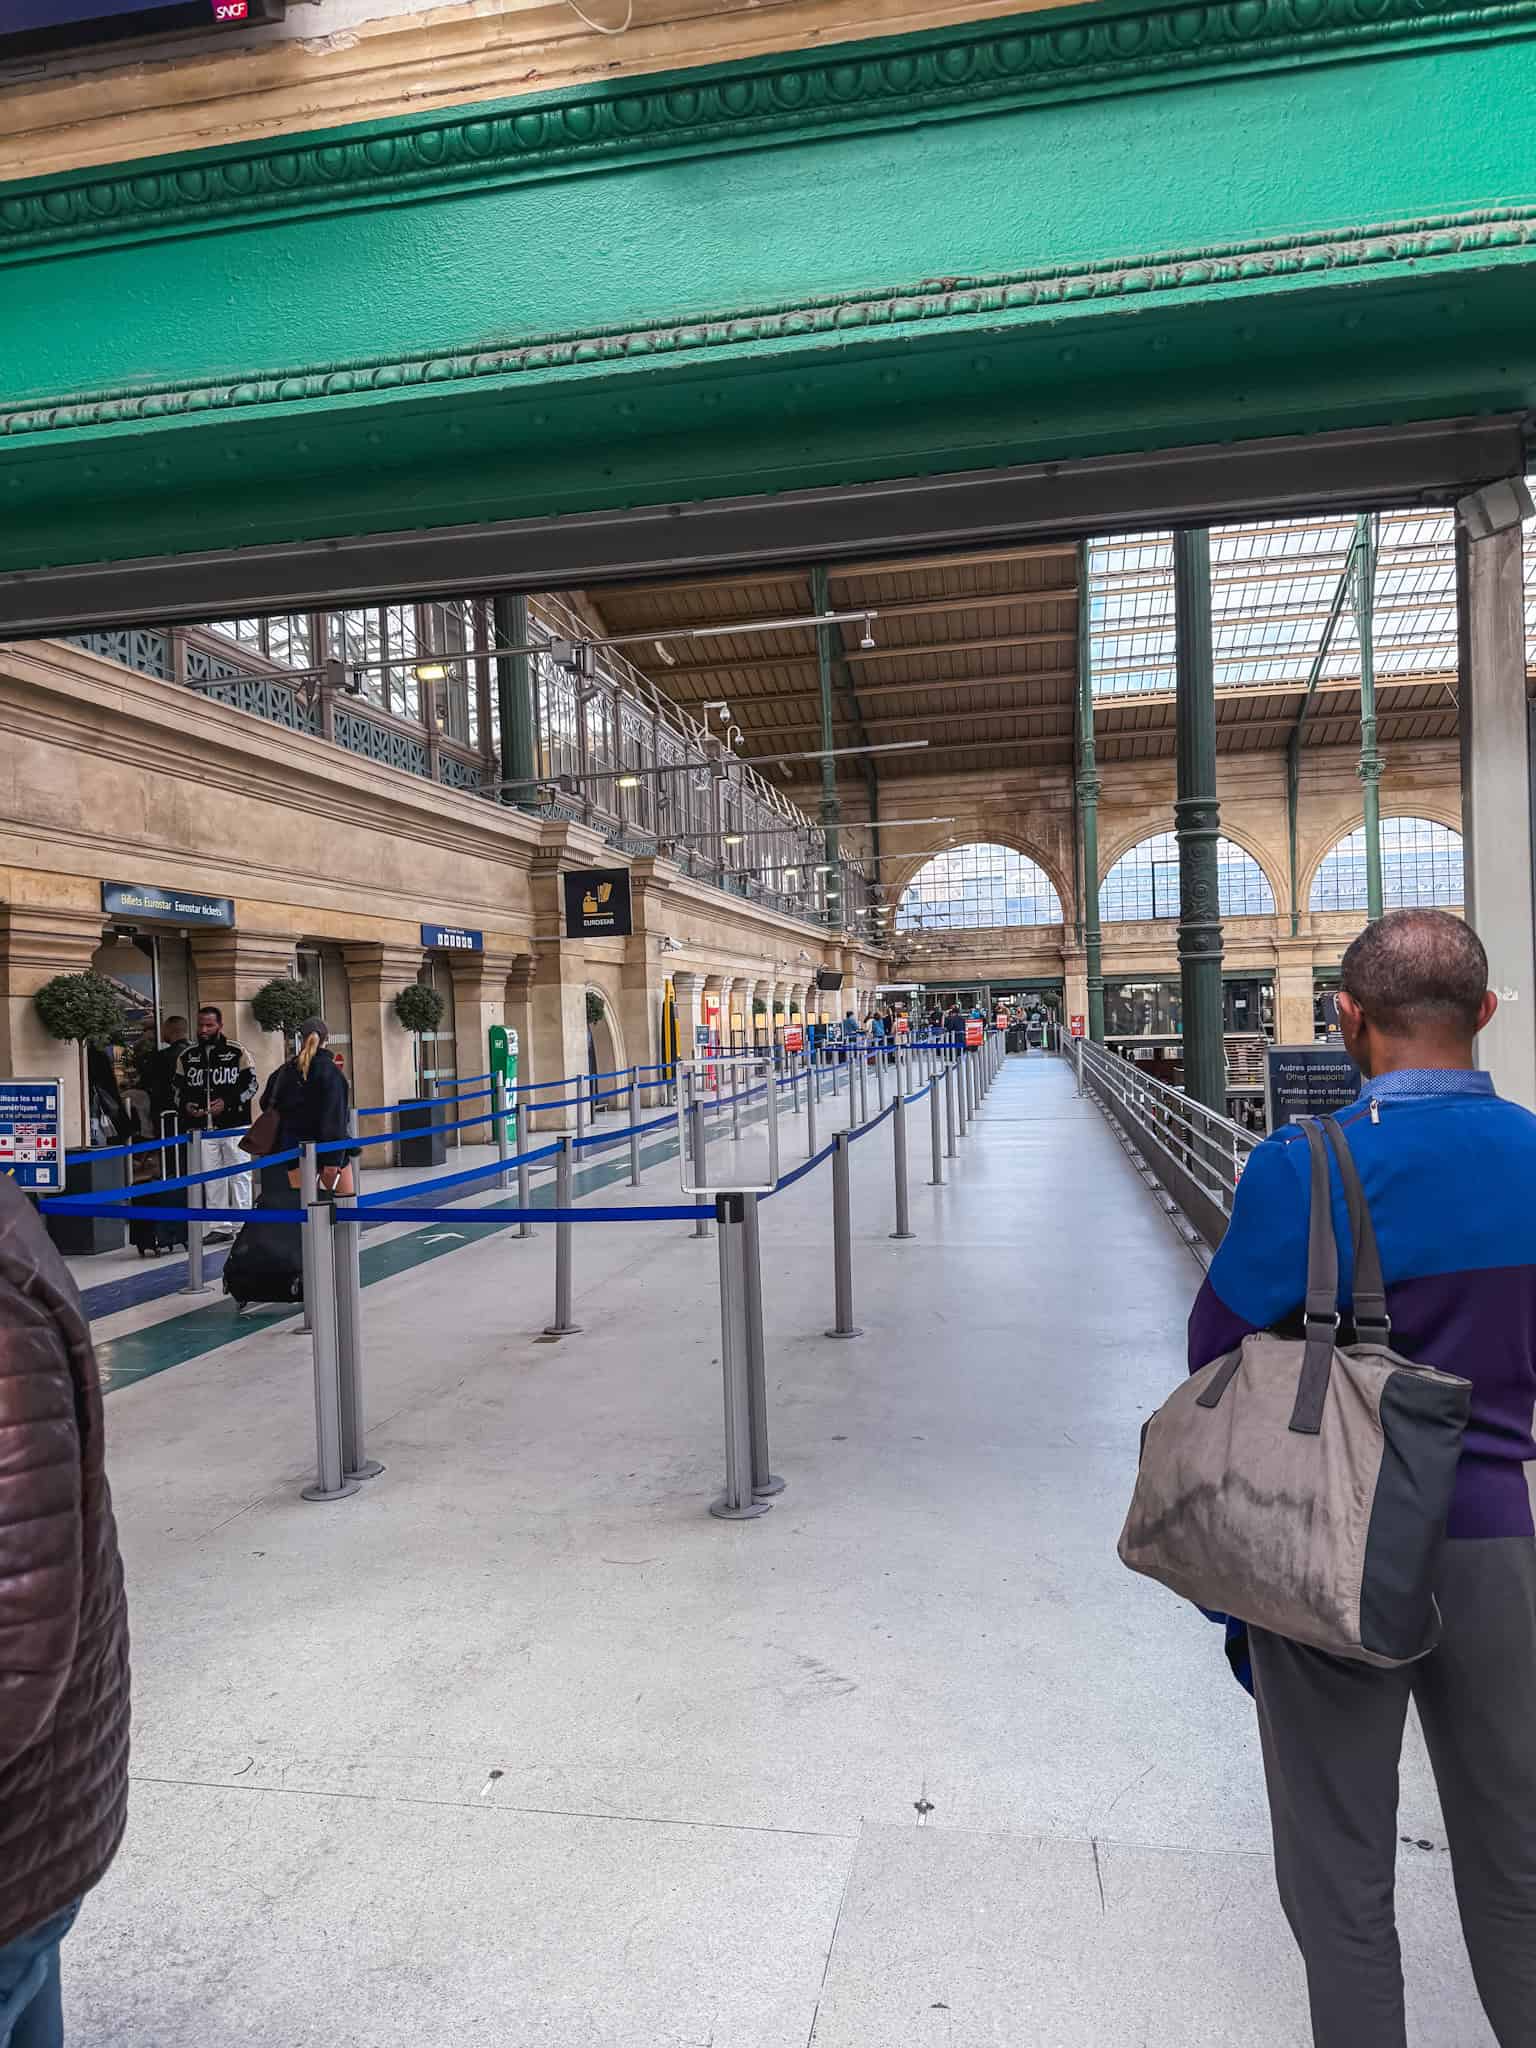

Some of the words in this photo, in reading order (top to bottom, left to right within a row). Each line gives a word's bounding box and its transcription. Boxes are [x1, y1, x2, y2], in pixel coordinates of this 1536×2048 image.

[216, 3, 246, 19] SNCF
[121, 894, 142, 906] Billets
[144, 896, 172, 910] Eurostar
[175, 900, 201, 914] Eurostar
[202, 903, 223, 917] tickets
[583, 918, 615, 926] EUROSTAR
[1279, 1063, 1305, 1072] Autres
[1306, 1063, 1352, 1073] passeports
